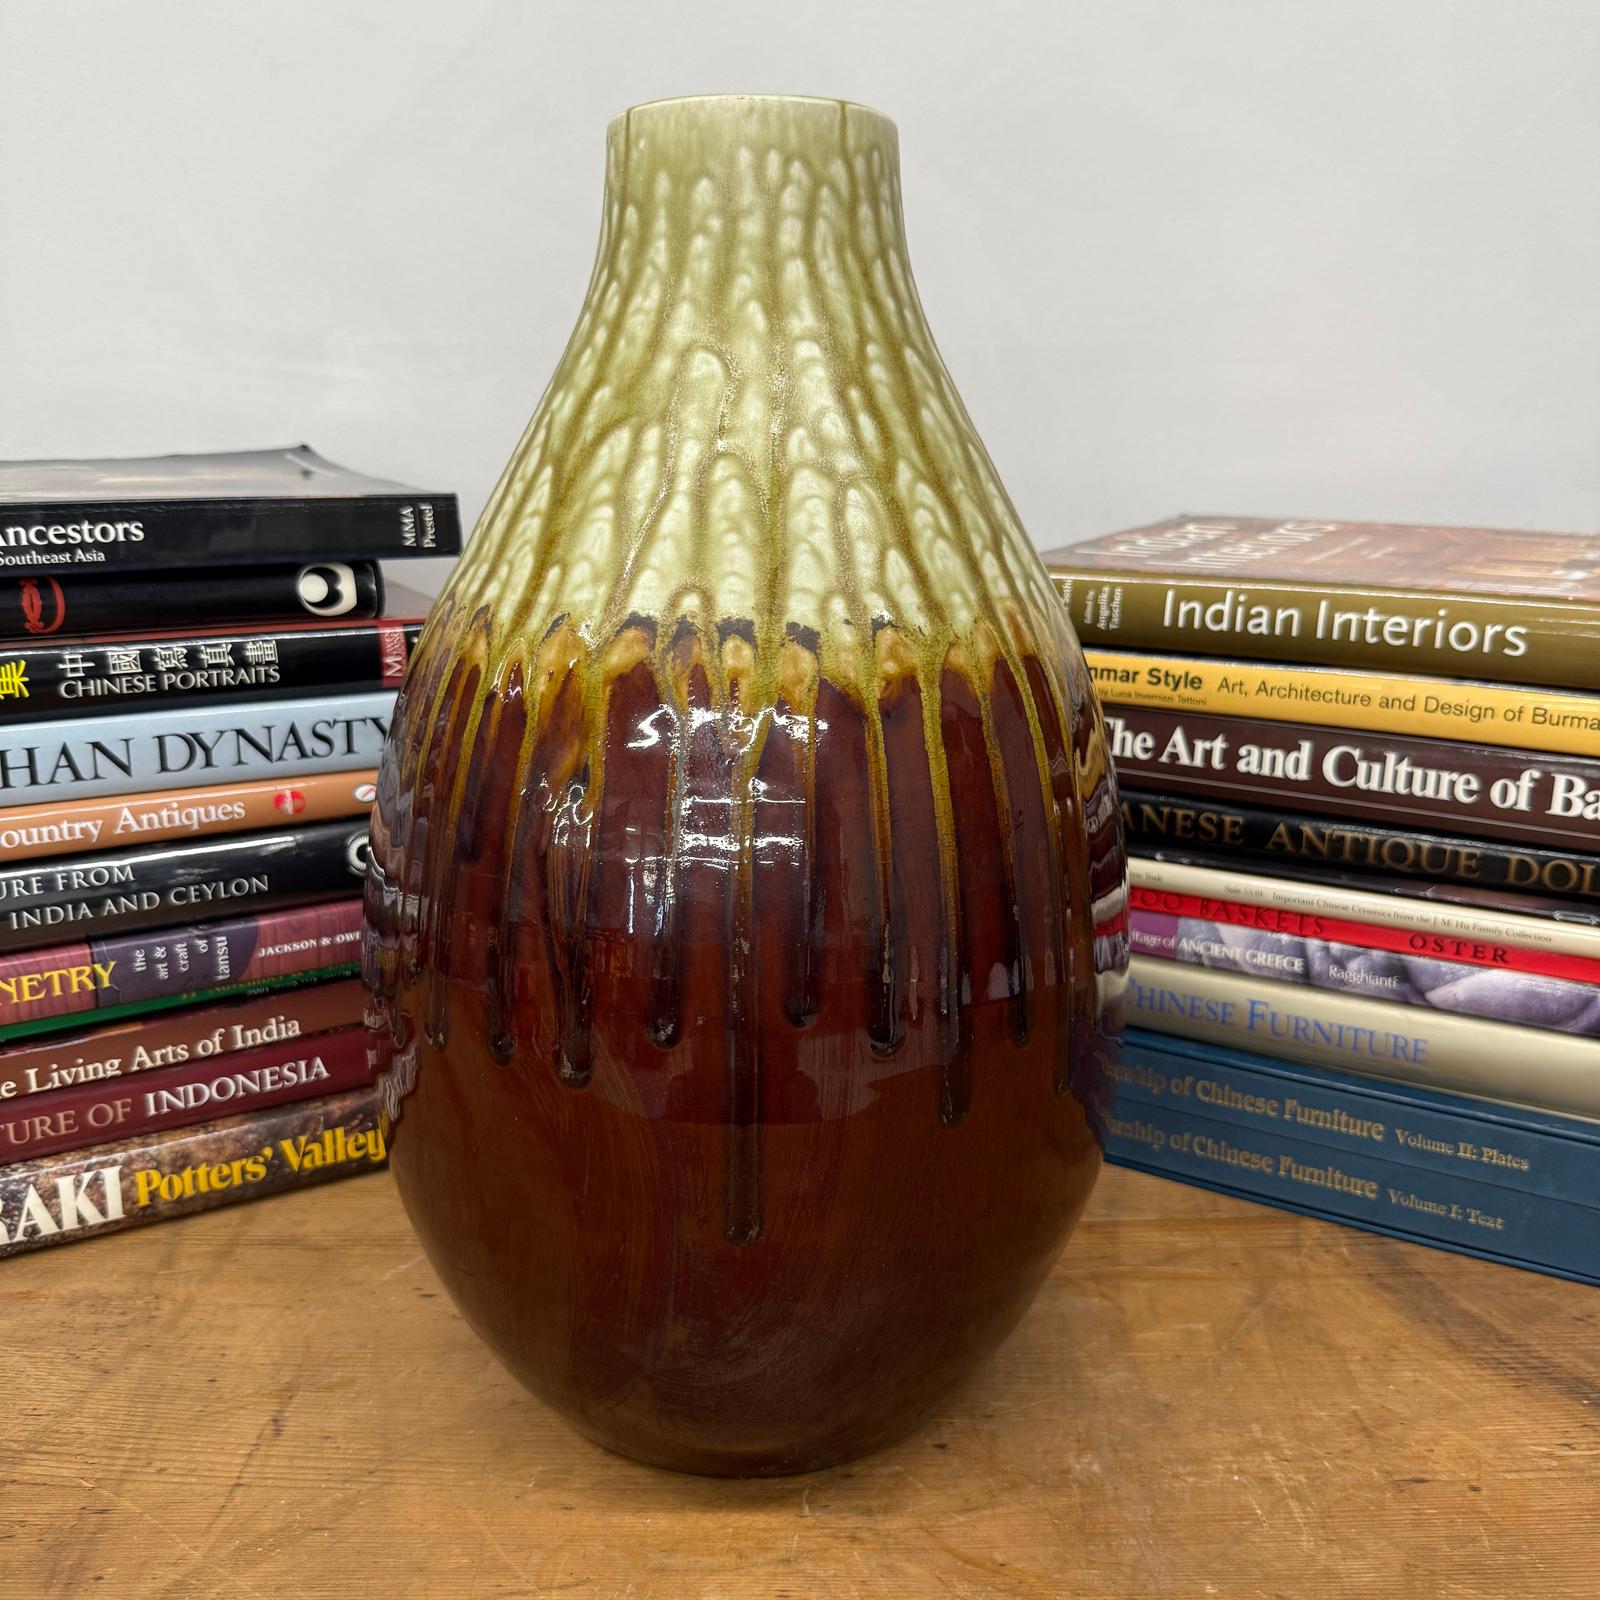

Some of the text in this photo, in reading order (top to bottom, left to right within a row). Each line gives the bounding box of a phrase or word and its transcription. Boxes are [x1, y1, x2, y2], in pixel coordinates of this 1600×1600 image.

[400, 506, 416, 546] MMA
[420, 503, 436, 547] Prestel
[75, 548, 106, 562] Asia
[1096, 585, 1110, 631] Angelika
[1109, 587, 1122, 631] Taschen
[1162, 589, 1529, 657] Indian Interiors
[59, 664, 281, 699] CHINESE PORTRAITS
[1147, 668, 1203, 692] Style
[1217, 676, 1249, 698] Art,
[1255, 680, 1371, 707] Architecture
[1378, 695, 1416, 712] and
[1424, 696, 1495, 723] Design
[1503, 705, 1524, 722] of
[1532, 707, 1600, 731] Burma
[0, 738, 134, 789] HAN
[1158, 725, 1230, 770] Art
[1236, 739, 1314, 781] and
[1322, 745, 1482, 804] Culture
[1489, 768, 1543, 811] of
[1545, 772, 1600, 820] Ba
[1, 801, 246, 848] ountry Antiques
[1265, 821, 1481, 878] ANTIQUE
[10, 874, 270, 930] INDIA AND CEYLON
[57, 865, 136, 891] FROM
[1201, 900, 1325, 936] BASKETS
[1408, 932, 1511, 965] OSTER
[1272, 892, 1314, 906] Important
[1316, 899, 1350, 912] Chinese
[1351, 904, 1392, 918] Ceramics
[1392, 910, 1414, 922] from
[1416, 914, 1431, 924] the
[1472, 922, 1502, 937] Family
[1504, 926, 1553, 942] Collection
[154, 946, 167, 959] &
[195, 939, 208, 954] of
[257, 938, 317, 958] JACKSON
[320, 936, 332, 947] &
[1178, 938, 1243, 961] ANCIENT
[1245, 948, 1305, 973] GREECE
[1329, 964, 1400, 989] Ragghianti
[1129, 977, 1429, 1063] HINESE FURNITURE
[0, 1016, 301, 1099] e Living Arts of India
[87, 1098, 132, 1128] OF
[145, 1056, 331, 1117] INDONESIA
[1170, 1075, 1194, 1097] of
[1196, 1080, 1279, 1117] Chinese
[1283, 1098, 1386, 1142] Furniture
[1394, 1128, 1454, 1156] Volume
[1481, 1146, 1530, 1171] Plates
[134, 1146, 274, 1207] Potters'
[280, 1127, 387, 1172] Valley
[1169, 1132, 1192, 1152] of
[1192, 1136, 1274, 1174] Chinese
[1279, 1155, 1379, 1199] Furniture
[1387, 1188, 1446, 1216] Volume
[1465, 1207, 1505, 1230] Text
